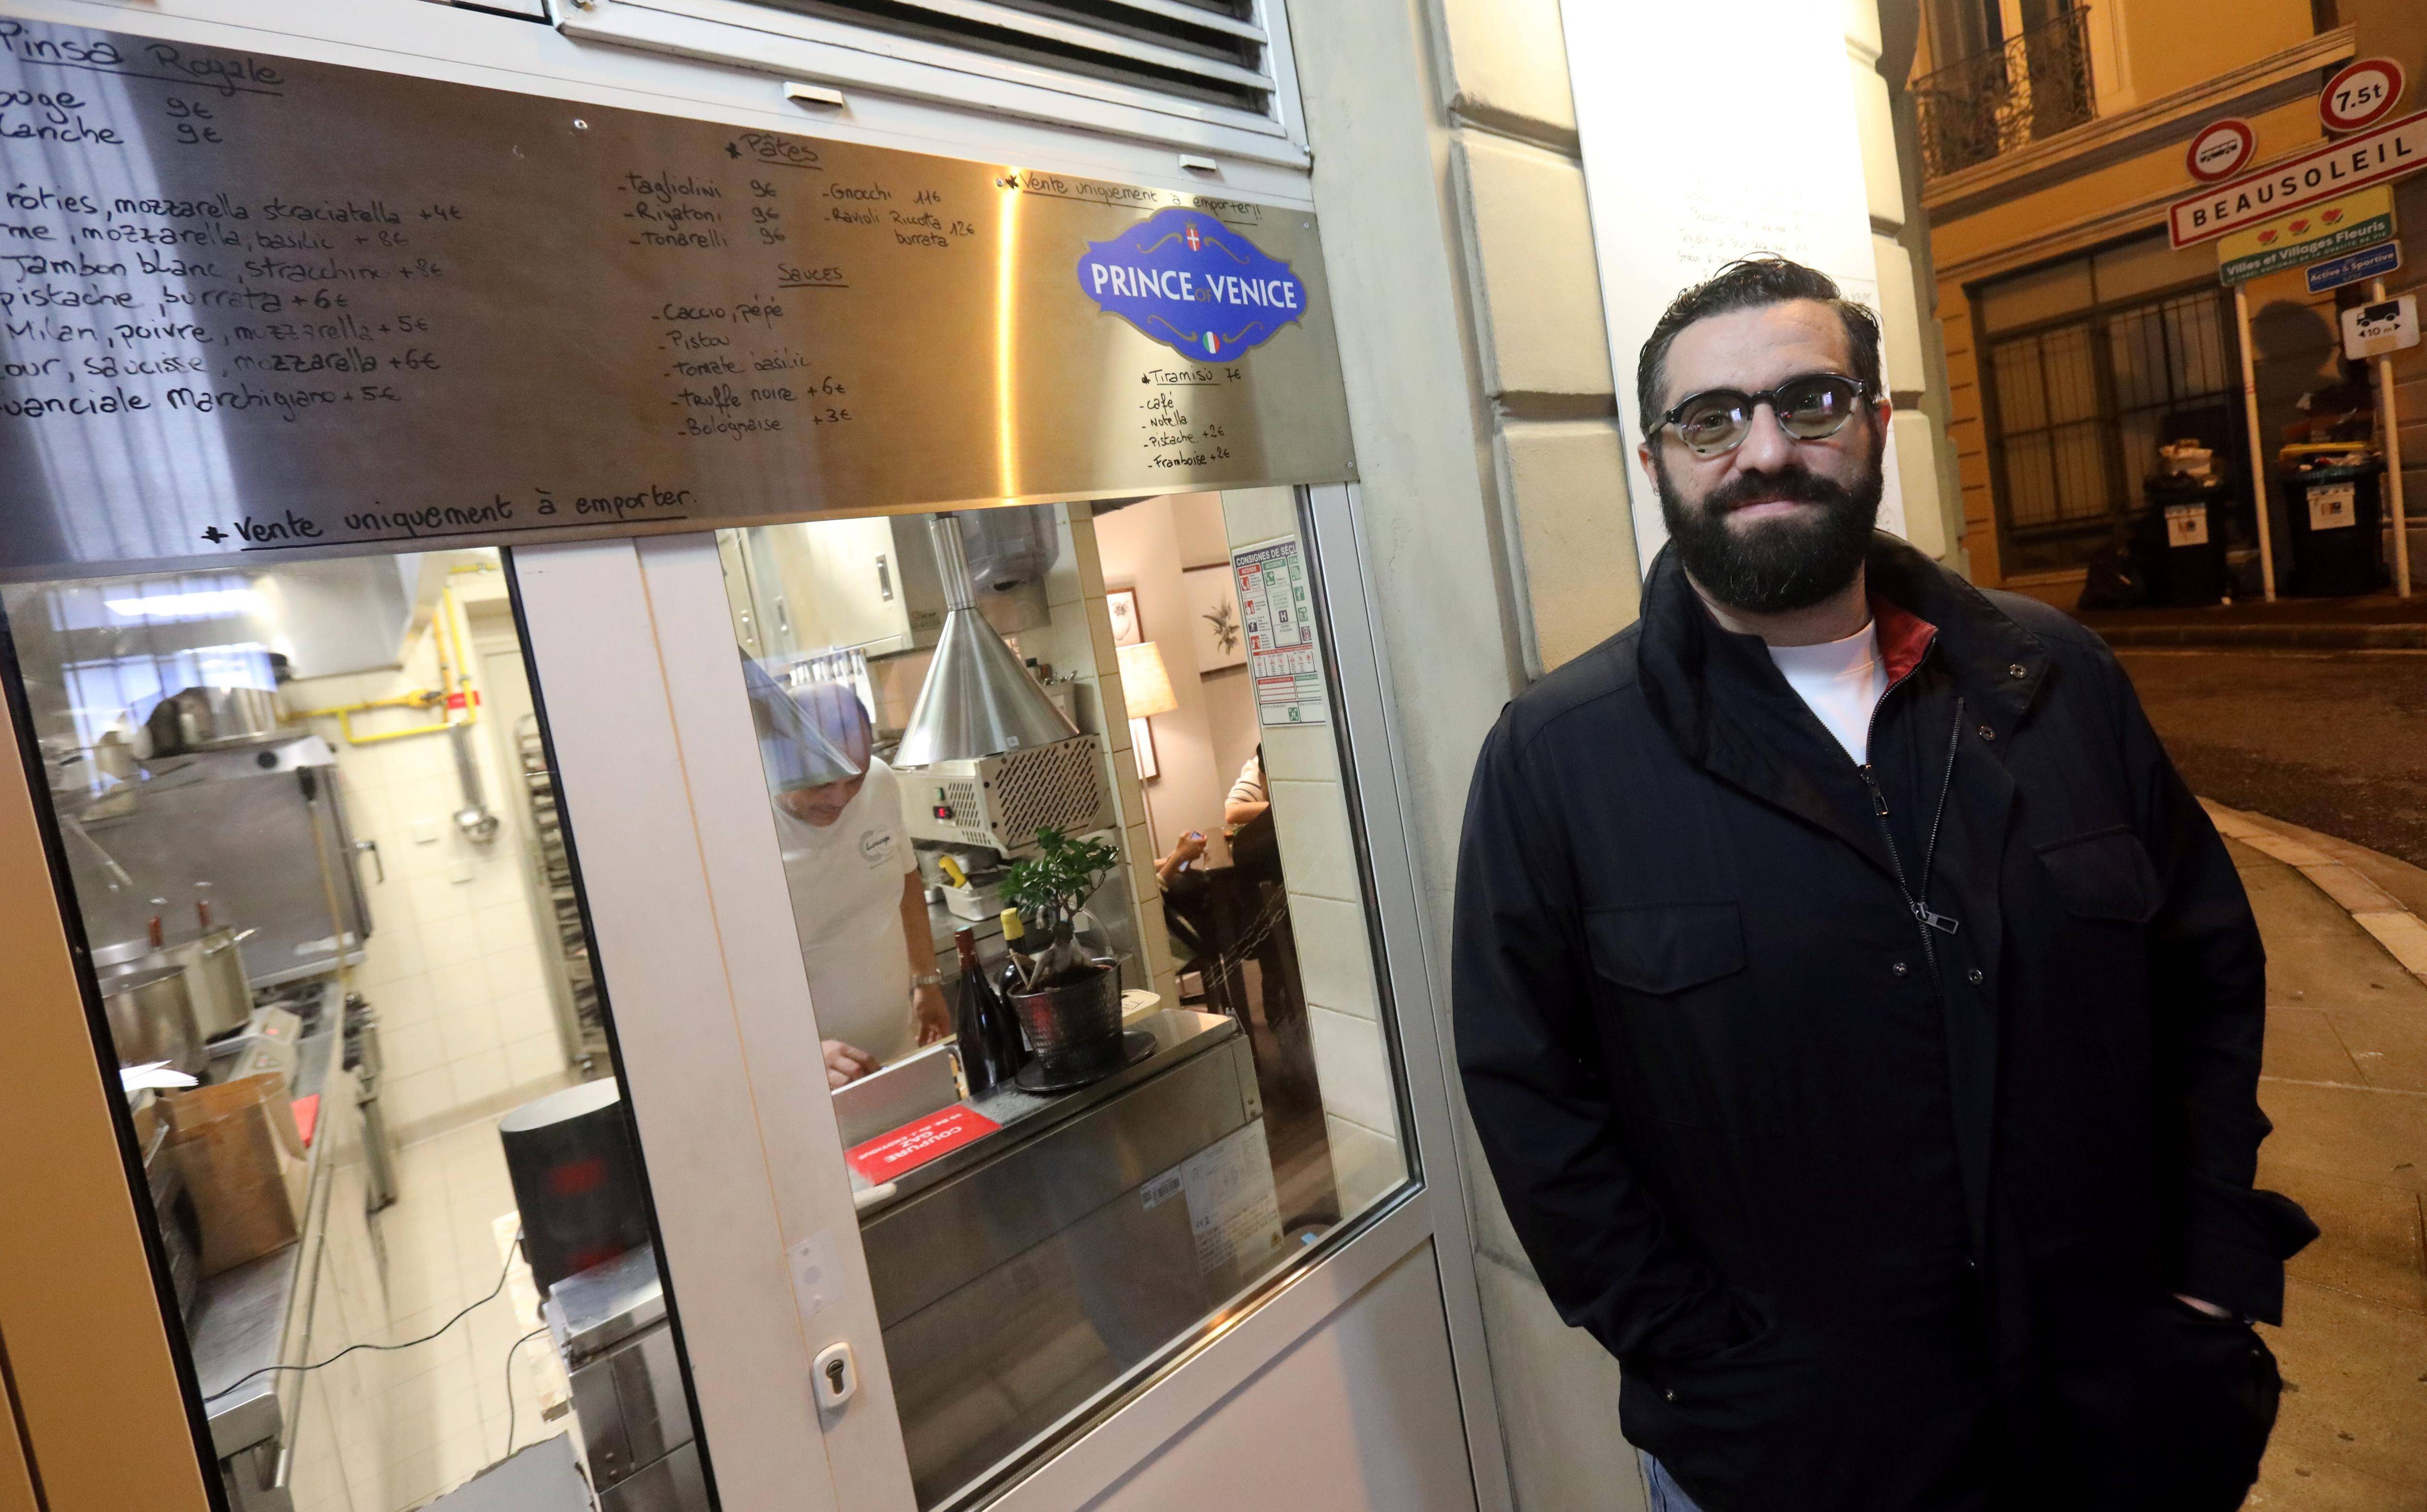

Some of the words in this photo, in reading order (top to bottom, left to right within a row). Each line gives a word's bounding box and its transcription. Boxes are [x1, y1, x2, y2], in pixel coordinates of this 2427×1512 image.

[0, 20, 123, 65] Pinsa
[146, 43, 284, 96] Royale
[2336, 83, 2383, 113] 7.5t
[739, 133, 818, 162] Pâtes
[1021, 173, 1067, 193] Vente
[1076, 179, 1158, 206] uniquement
[2193, 137, 2412, 228] BEAUSOLEIL
[2227, 260, 2261, 276] Villes
[2262, 254, 2277, 265] et
[2279, 238, 2333, 260] Villages
[2336, 221, 2385, 243] Fleuris
[2310, 268, 2341, 283] Active
[2351, 252, 2395, 270] Sportive
[1091, 263, 1196, 301] PRINCE
[1194, 287, 1212, 302] OF
[1205, 274, 1297, 309] VENICE
[2367, 327, 2380, 336] 10
[234, 510, 324, 542] Vente
[344, 494, 513, 538] uniquement
[535, 487, 557, 515] à
[1236, 550, 1270, 566] CONSIGNES
[1270, 548, 1280, 558] DE
[1265, 560, 1284, 568] ACCIDENT
[883, 1126, 963, 1163] COUPURE
[900, 1130, 934, 1148] GAZ
